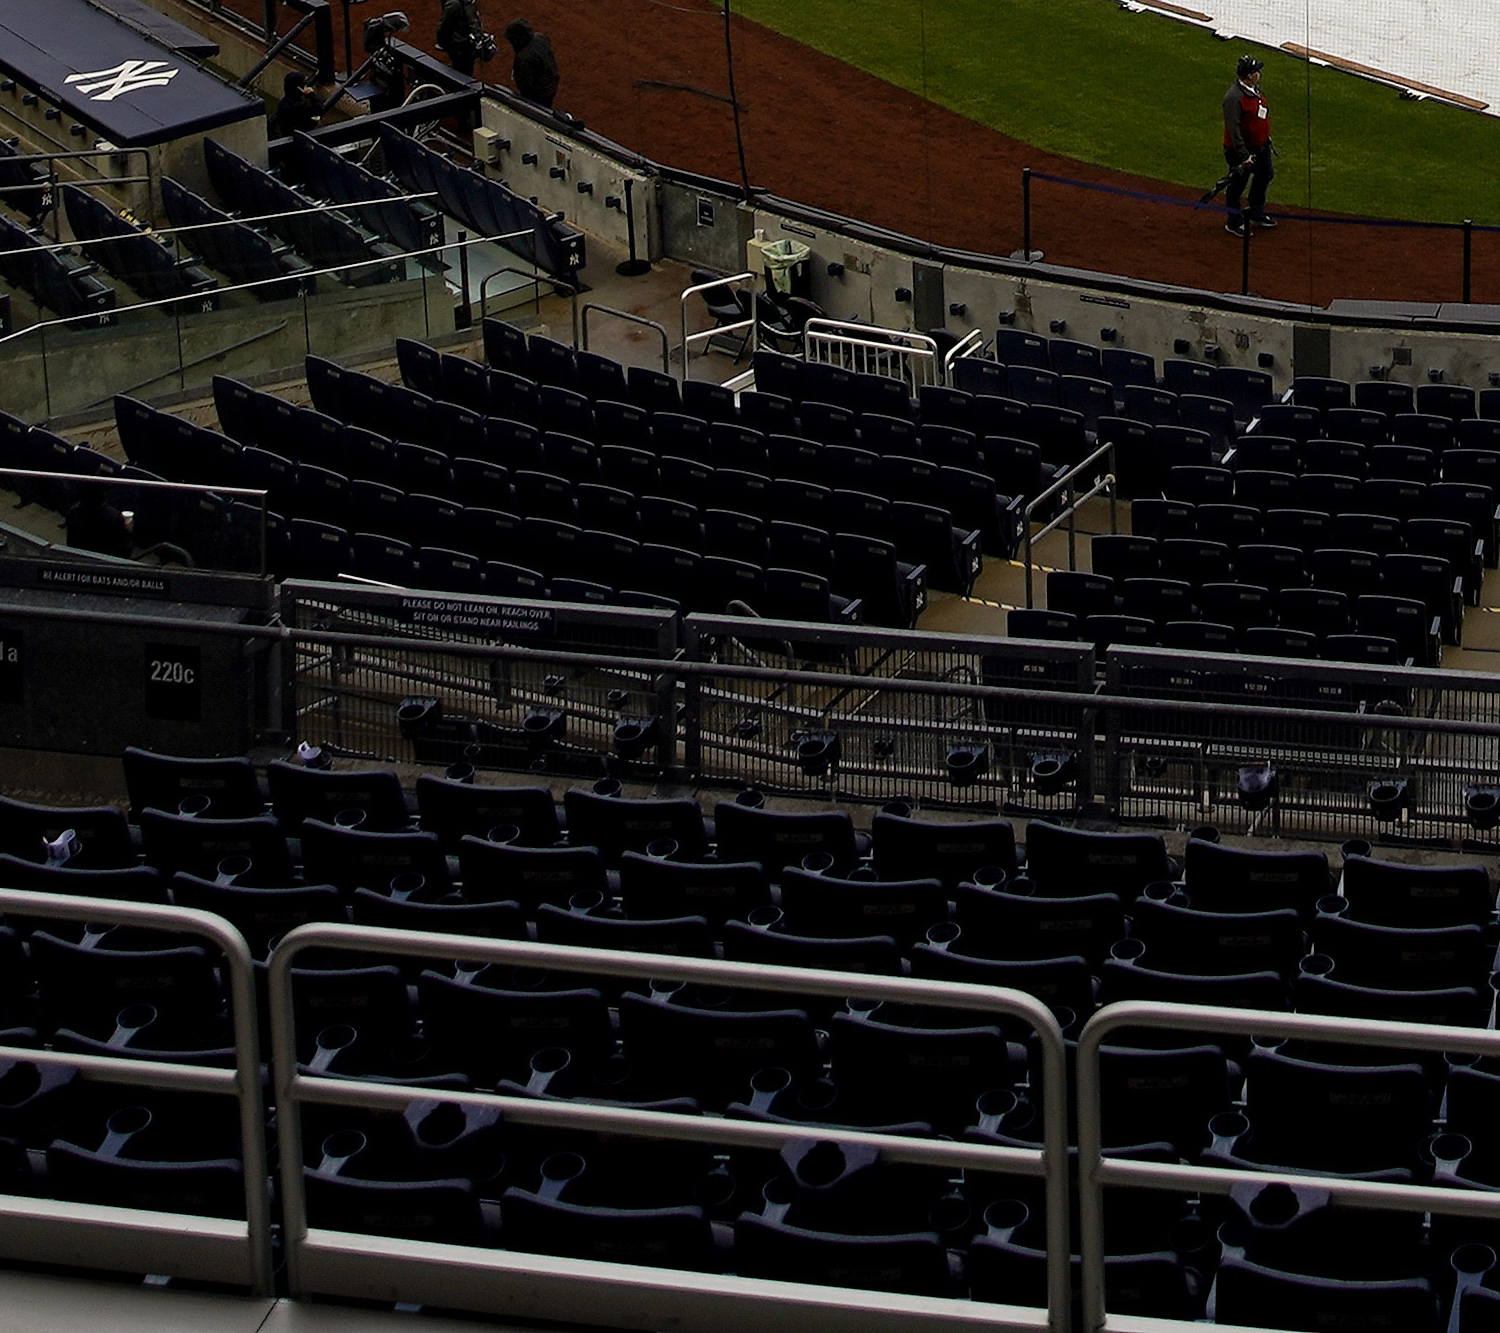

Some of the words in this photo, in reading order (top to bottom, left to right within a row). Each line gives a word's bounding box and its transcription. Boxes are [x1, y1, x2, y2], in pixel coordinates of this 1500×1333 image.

[142, 579, 164, 590] BALLS
[403, 598, 431, 609] PLEASE
[433, 600, 445, 610] DO
[454, 615, 478, 625] STAND
[150, 660, 194, 684] 220c
